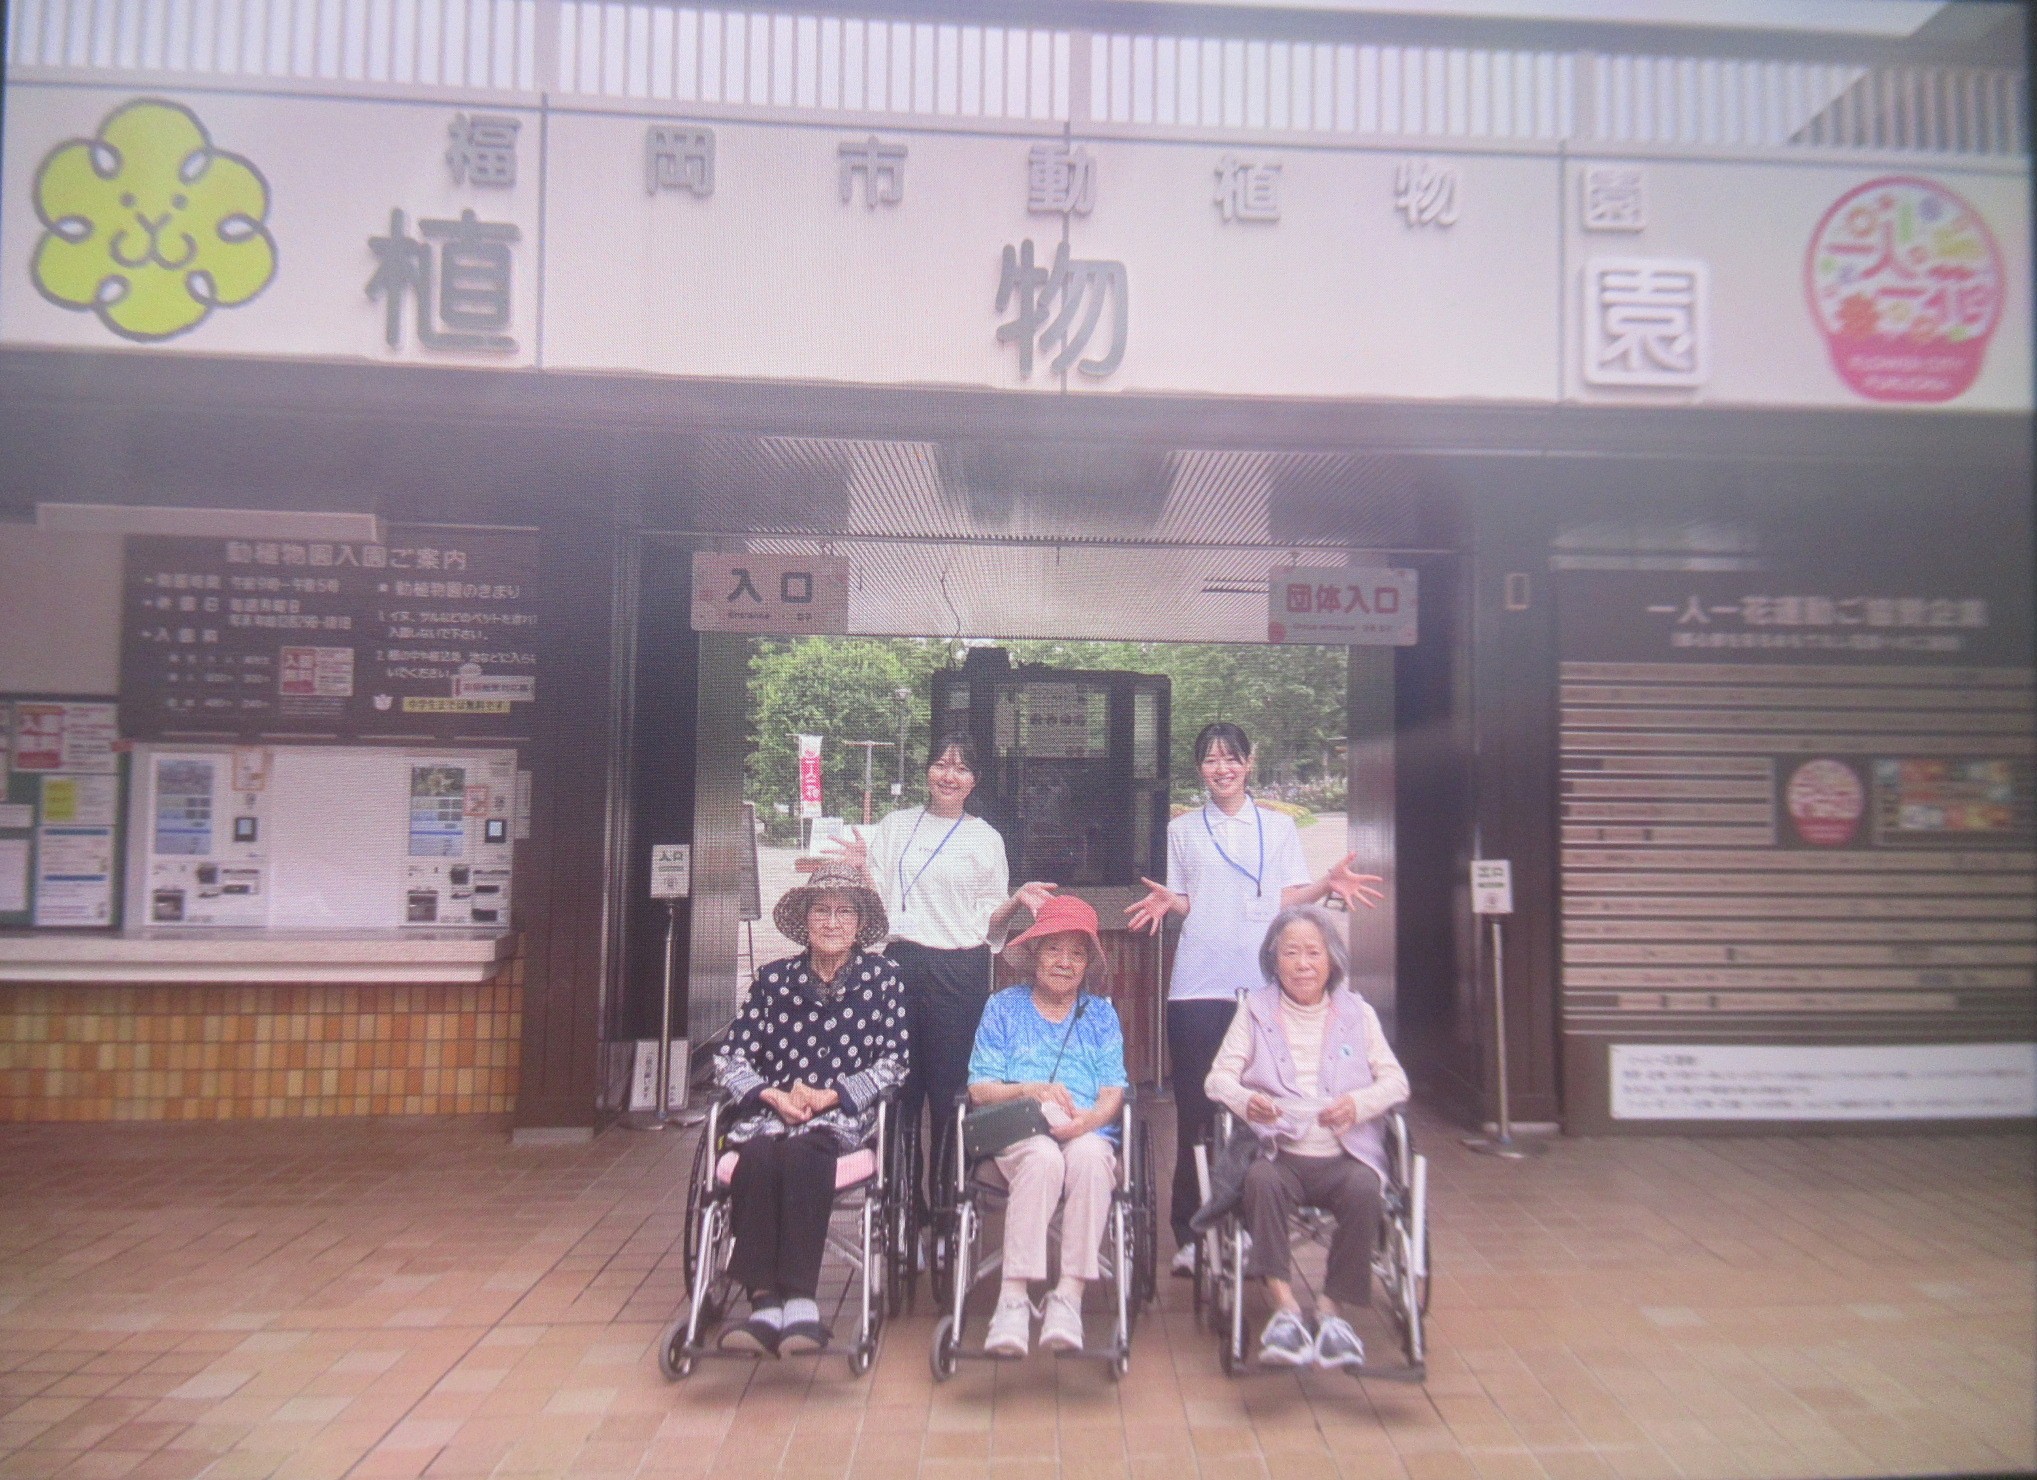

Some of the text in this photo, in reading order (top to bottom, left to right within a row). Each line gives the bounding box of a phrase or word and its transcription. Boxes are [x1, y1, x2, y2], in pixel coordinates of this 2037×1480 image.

[726, 567, 813, 604] 入口
[1285, 582, 1400, 615] 団体入口
